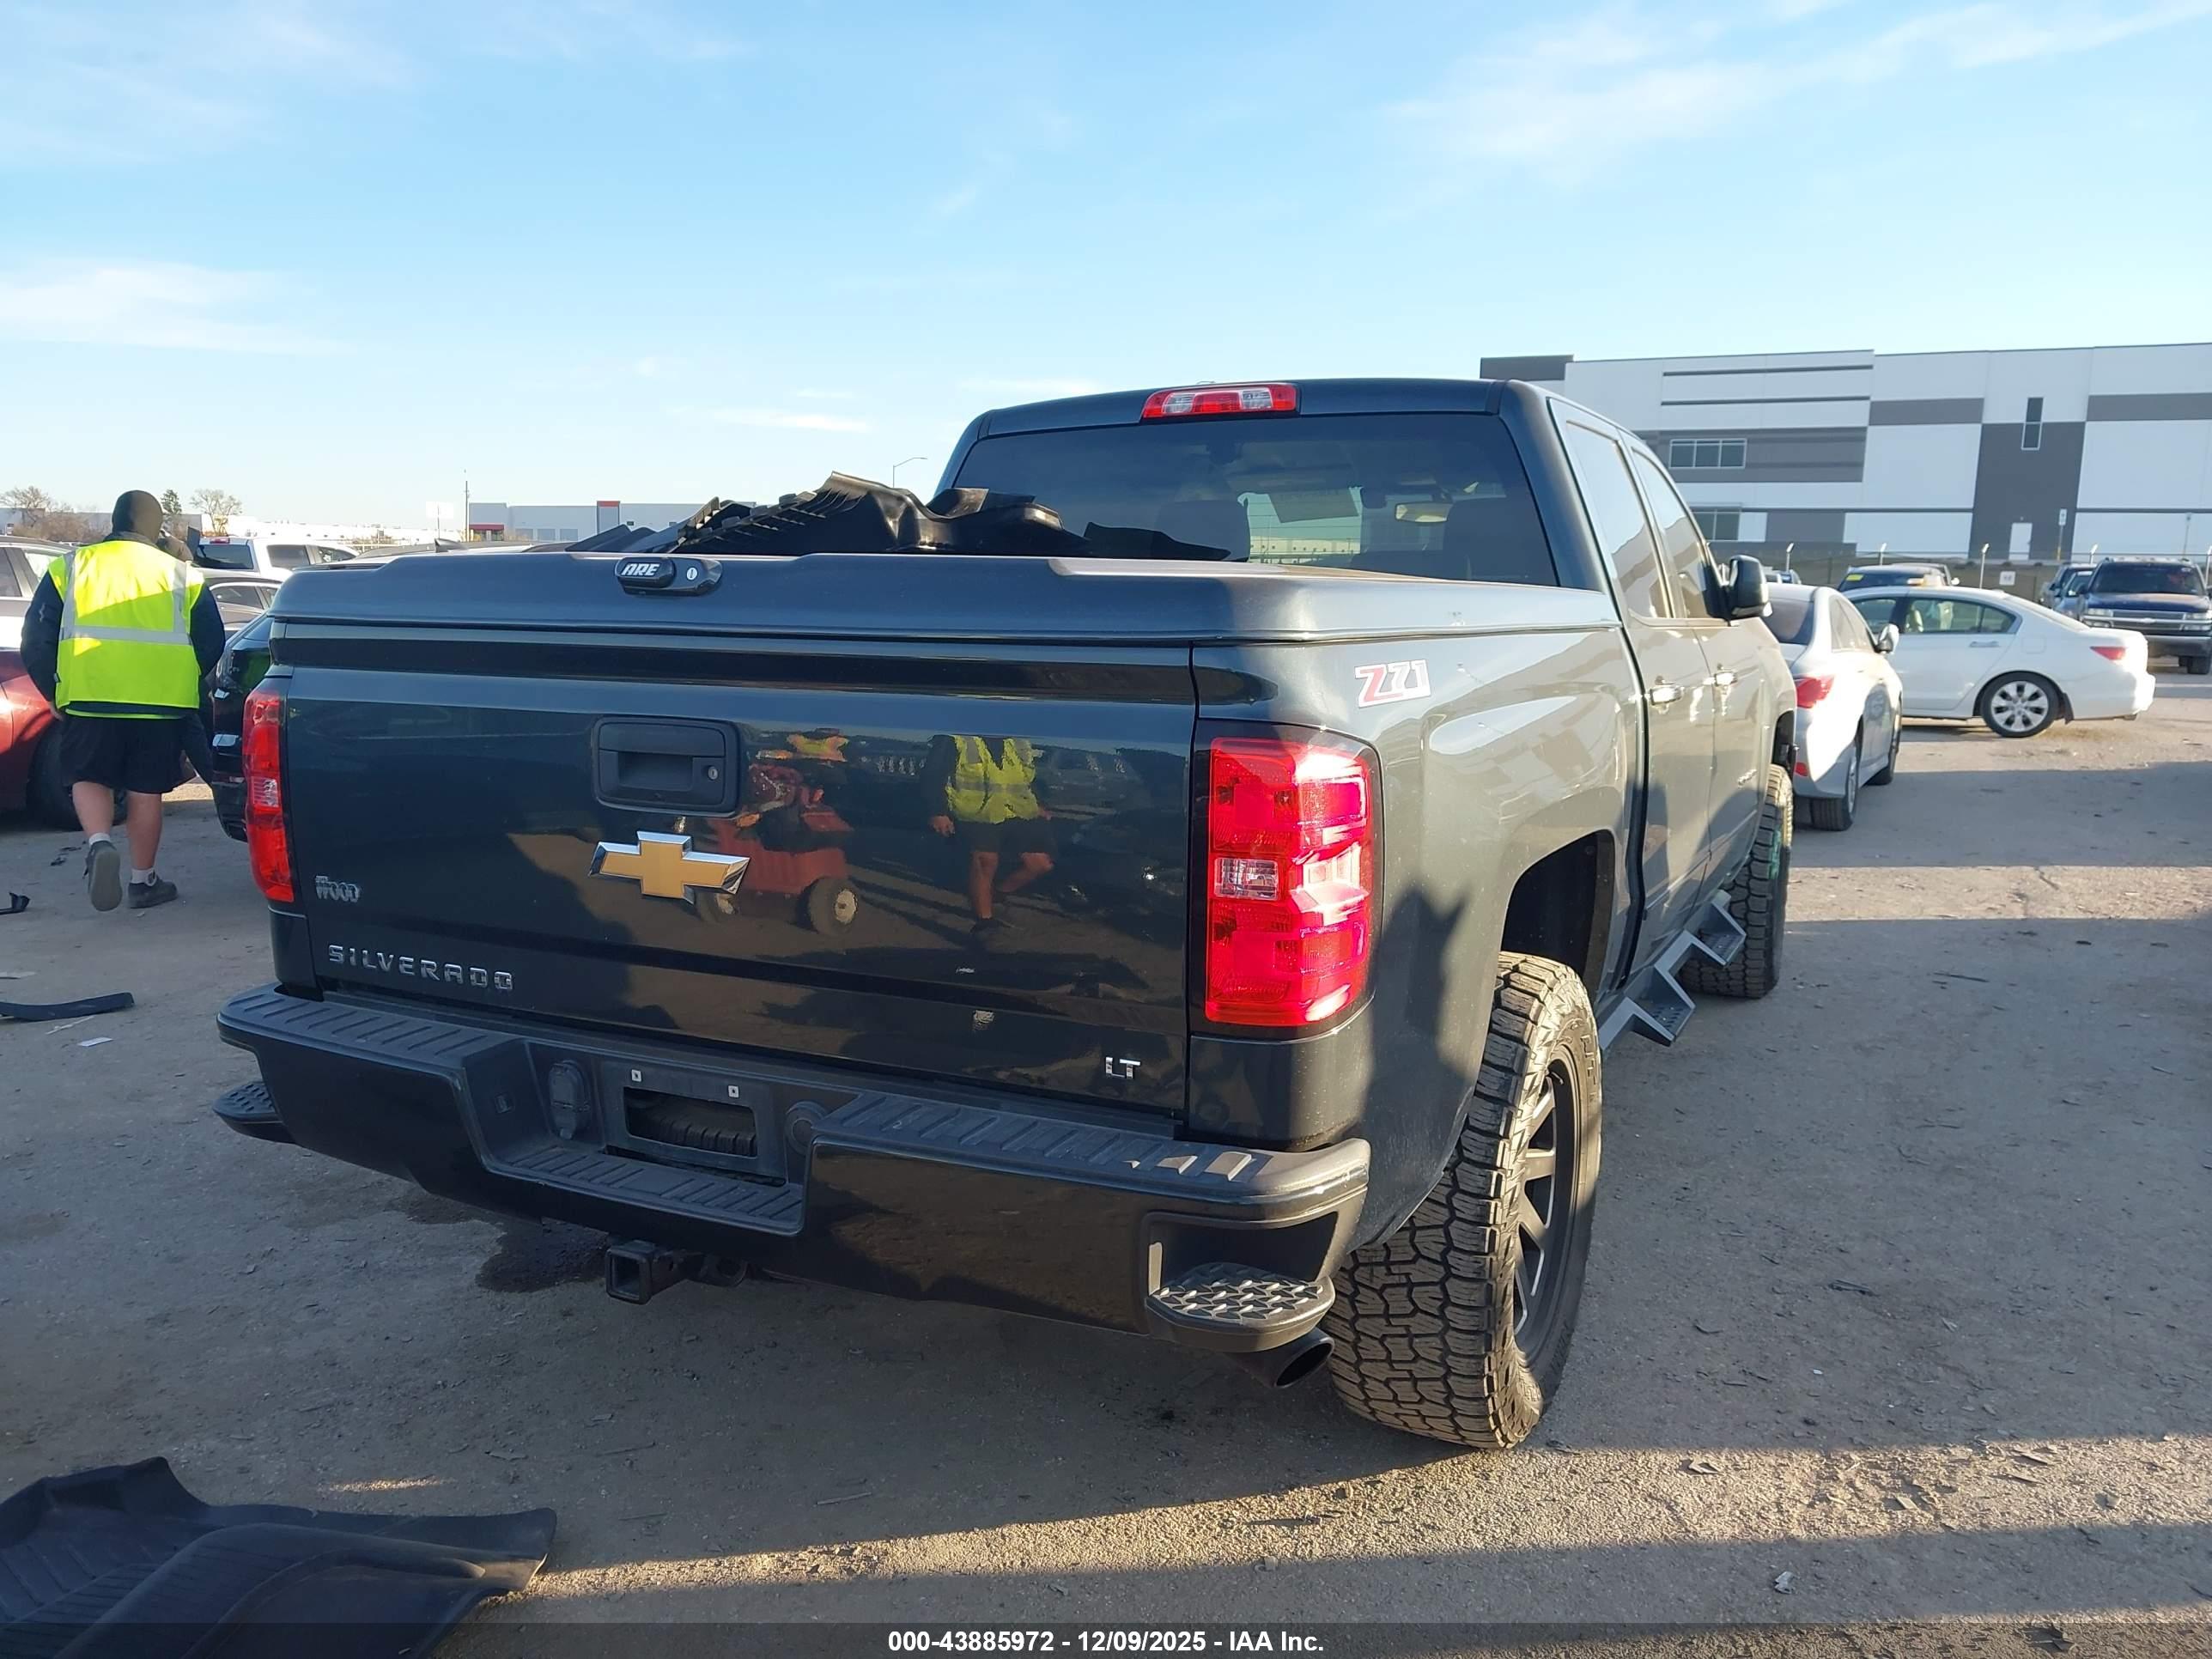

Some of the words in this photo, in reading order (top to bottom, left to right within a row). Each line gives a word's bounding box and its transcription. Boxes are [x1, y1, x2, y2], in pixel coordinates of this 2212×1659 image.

[621, 562, 660, 576] ARE
[1354, 659, 1431, 708] Z71
[328, 944, 514, 991] SILVERADO
[1105, 1056, 1141, 1079] LT
